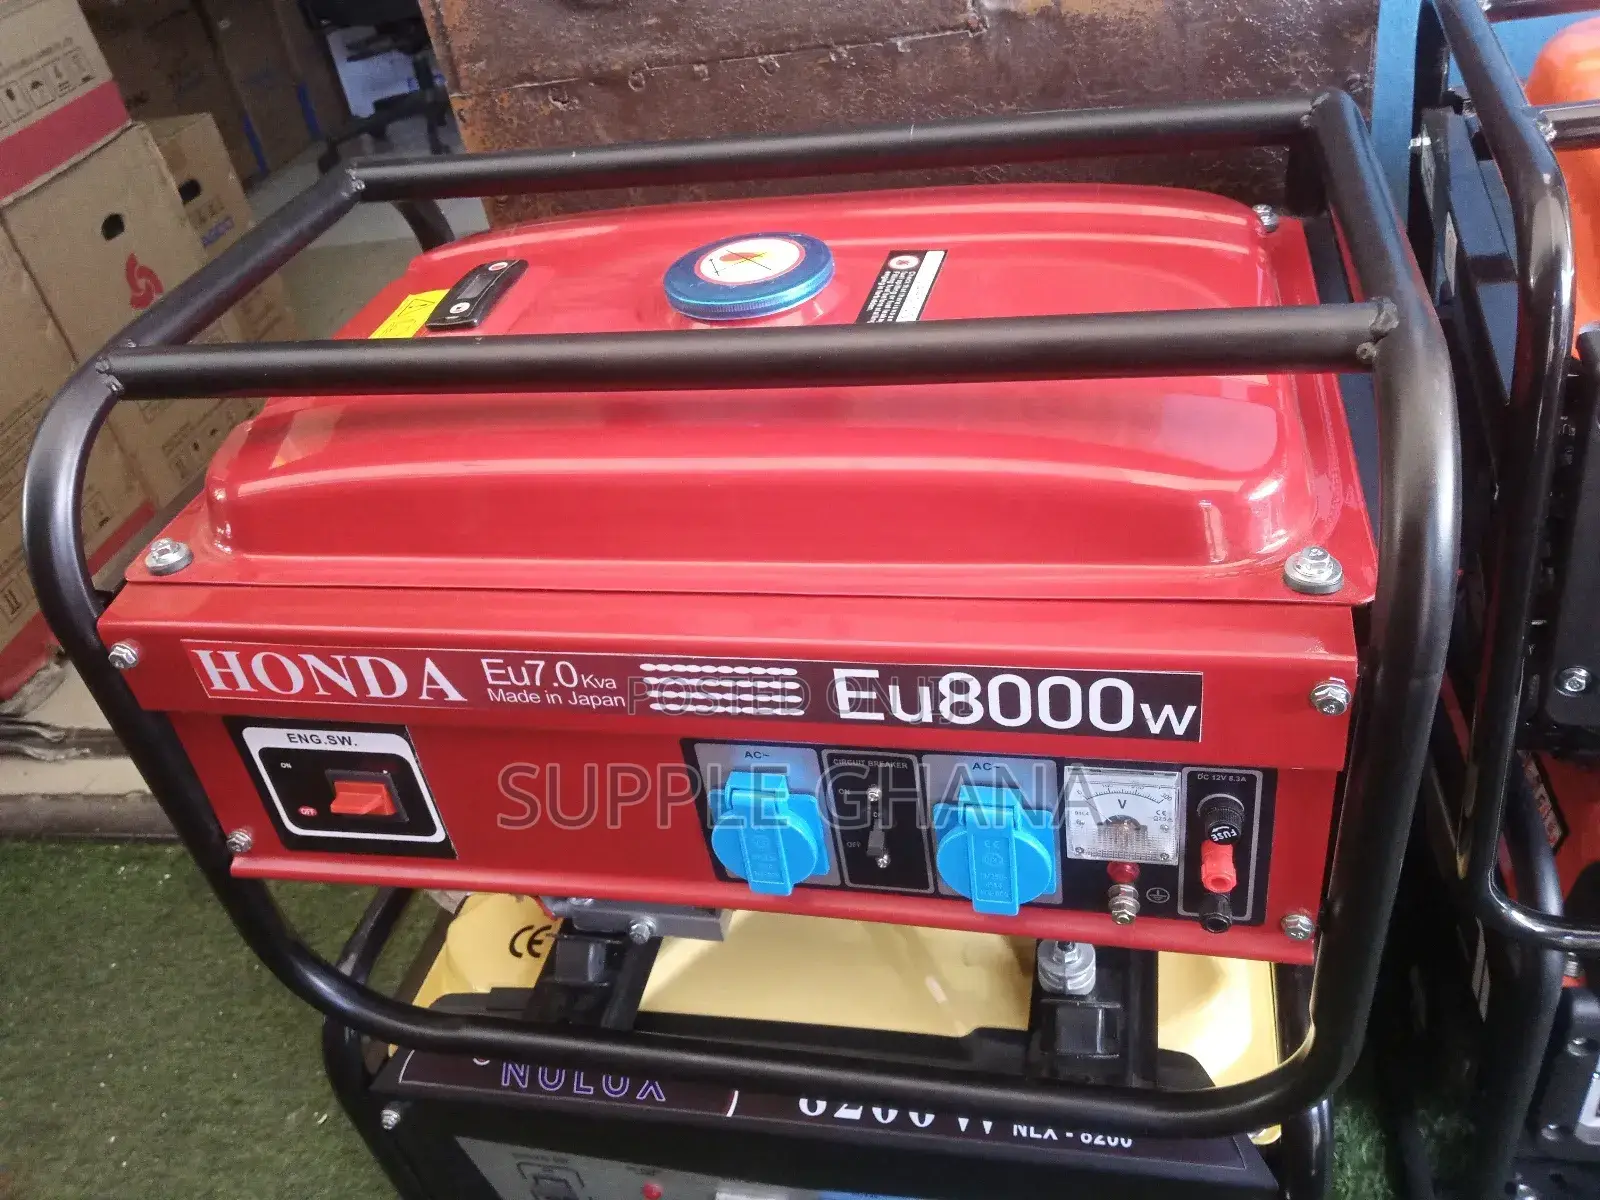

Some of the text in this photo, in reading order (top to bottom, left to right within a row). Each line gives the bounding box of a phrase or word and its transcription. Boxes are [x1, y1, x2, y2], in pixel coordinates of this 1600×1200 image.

[191, 649, 468, 702] HONDA
[486, 687, 626, 709] Made in Japan
[833, 758, 908, 769] CIRCUIT BREAKER
[1197, 772, 1209, 781] DC
[1211, 774, 1227, 782] 12V
[1117, 798, 1127, 809] V
[1210, 828, 1238, 843] FUSE
[508, 925, 553, 959] CE
